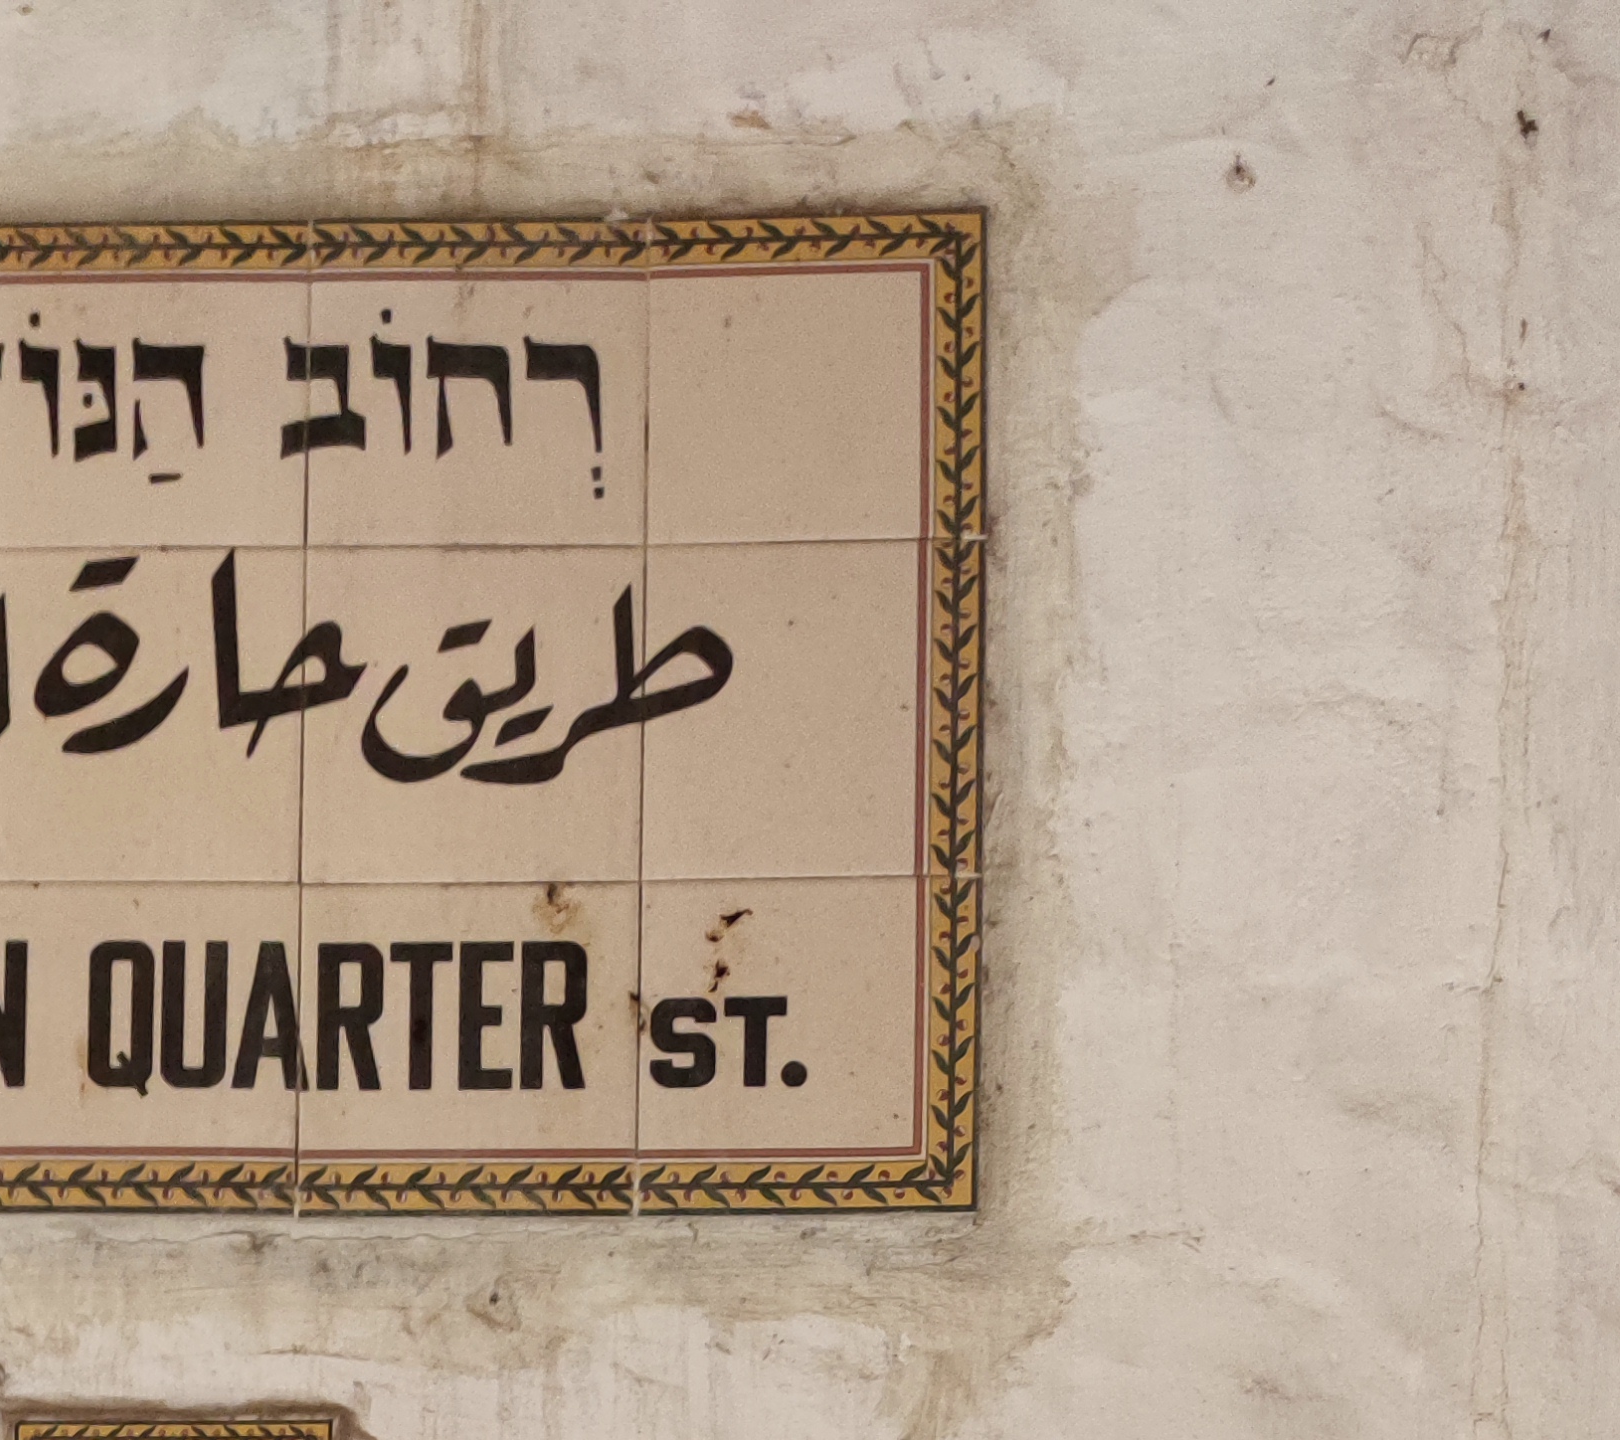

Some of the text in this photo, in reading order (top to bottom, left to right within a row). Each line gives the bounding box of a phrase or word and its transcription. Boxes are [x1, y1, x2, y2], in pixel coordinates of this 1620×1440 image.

[32, 546, 368, 759] حارة
[361, 581, 734, 785] طريق
[86, 939, 589, 1098] QUARTER
[648, 994, 809, 1090] ST.
